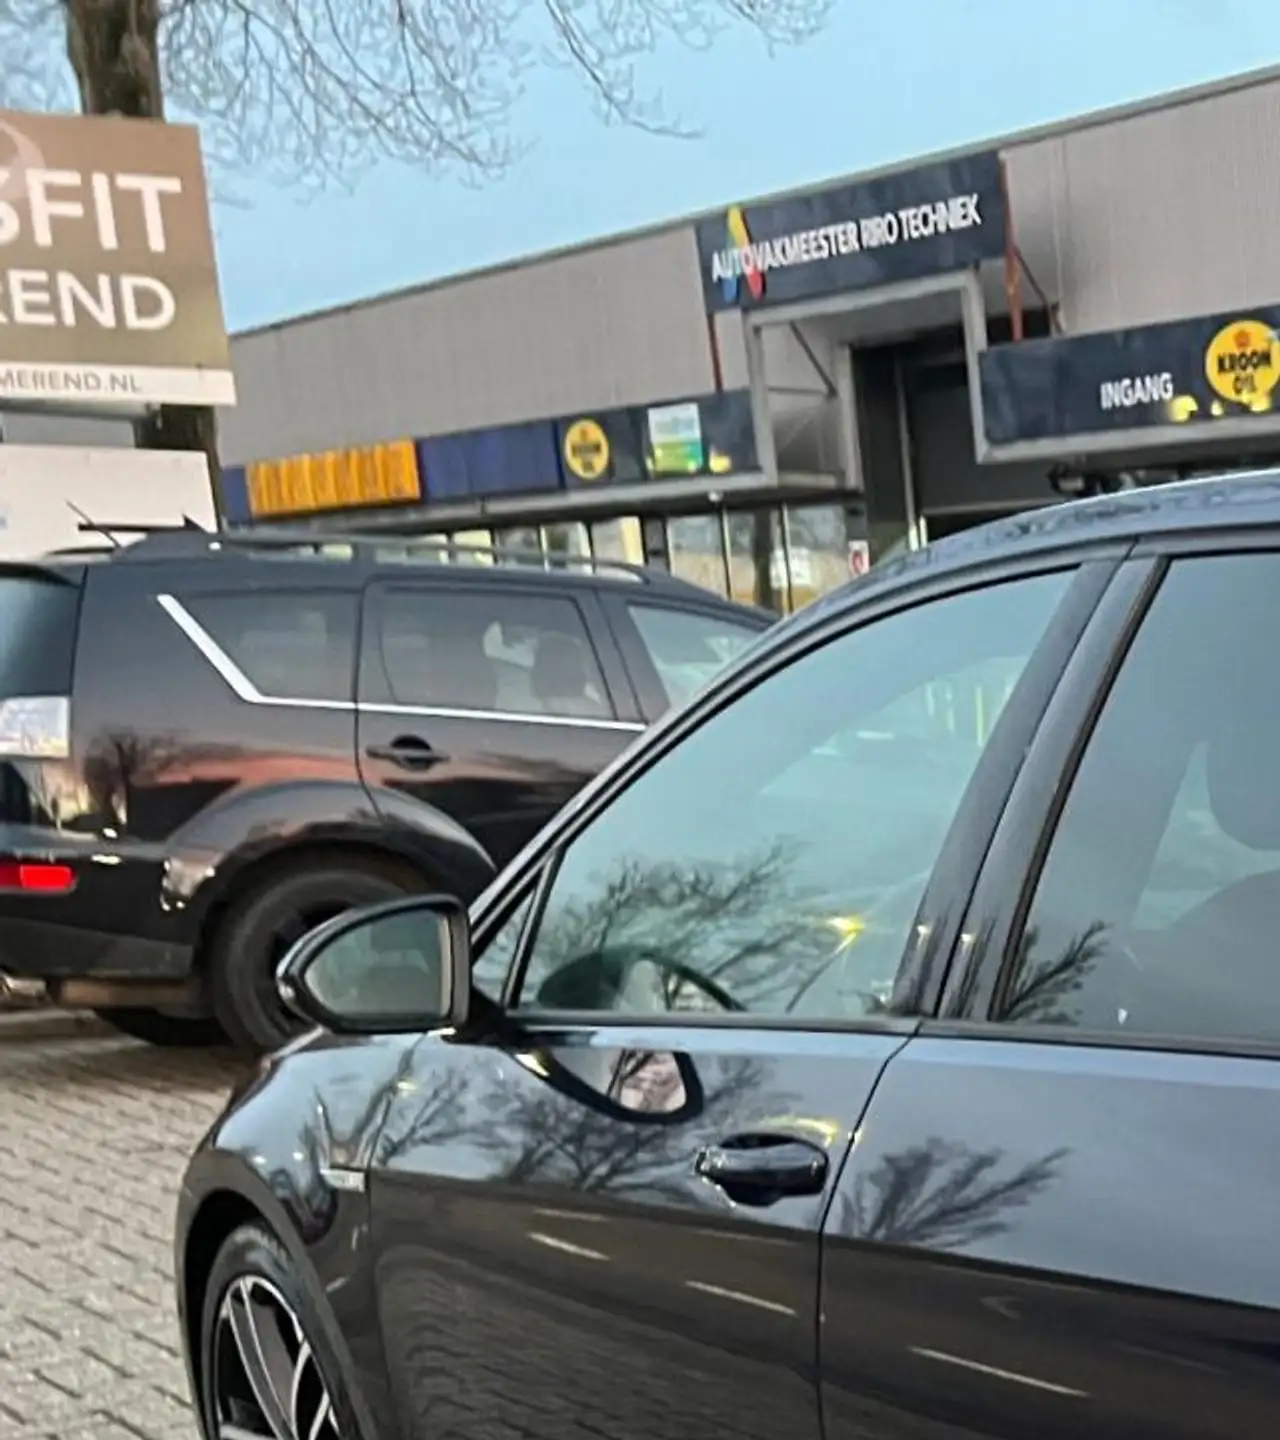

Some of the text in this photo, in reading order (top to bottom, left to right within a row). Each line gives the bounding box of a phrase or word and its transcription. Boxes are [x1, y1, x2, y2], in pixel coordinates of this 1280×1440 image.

[712, 220, 860, 284] AUTOVAKMEESTER
[899, 193, 983, 241] TECHNIEK
[0, 268, 177, 331] END
[1217, 350, 1272, 374] KROON
[1100, 371, 1174, 410] INGANG
